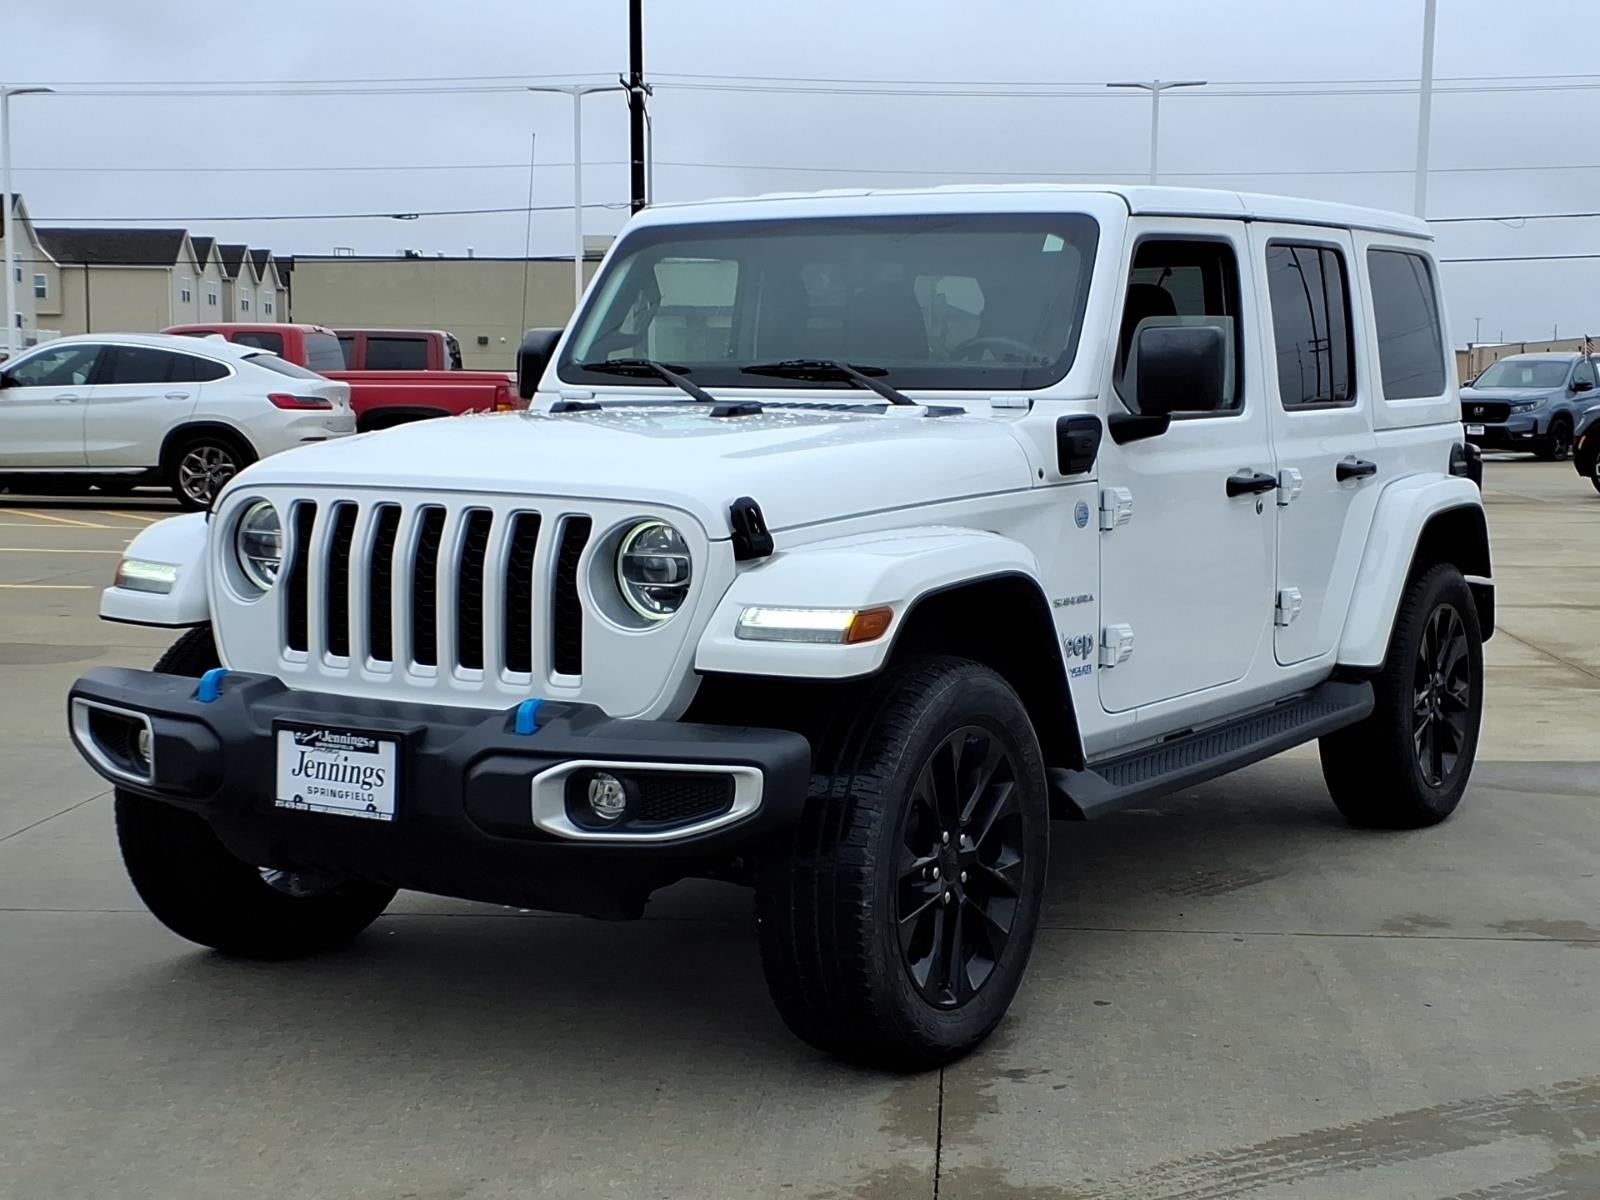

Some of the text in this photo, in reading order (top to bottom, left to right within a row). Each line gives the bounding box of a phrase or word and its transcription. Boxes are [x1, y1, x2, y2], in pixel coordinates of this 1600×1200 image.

[322, 731, 369, 748] Jennings
[291, 750, 386, 791] Jennings
[306, 786, 375, 802] SPRINGFIELD
